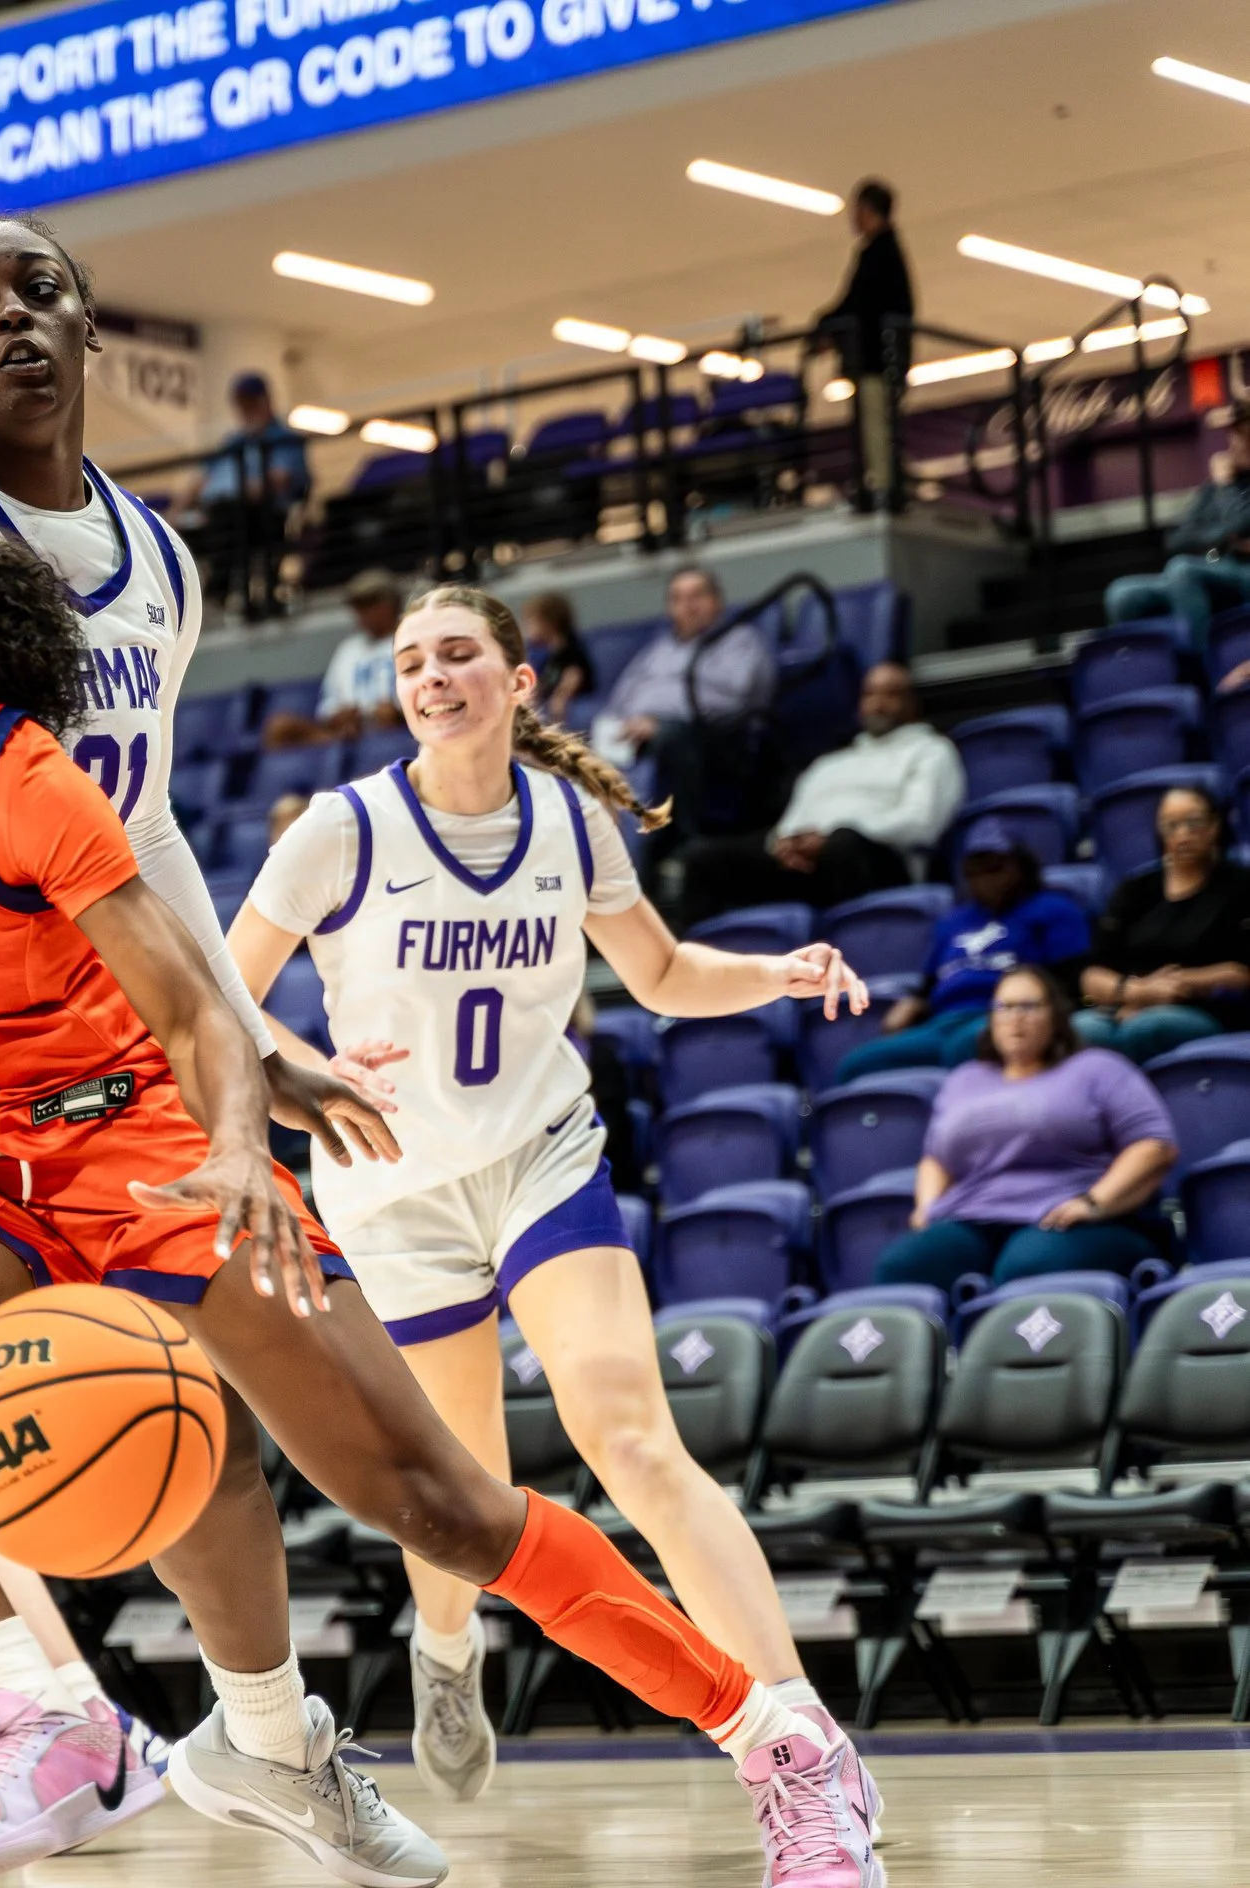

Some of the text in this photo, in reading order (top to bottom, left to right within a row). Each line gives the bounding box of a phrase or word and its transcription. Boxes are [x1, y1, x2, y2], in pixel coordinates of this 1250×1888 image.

[124, 1, 229, 75] THE
[101, 78, 207, 156] THE
[211, 57, 293, 129] QR
[298, 16, 453, 107] CODE
[454, 0, 535, 67] TO
[397, 916, 556, 971] FURMAN
[454, 987, 504, 1087] 0
[110, 1082, 128, 1097] 42
